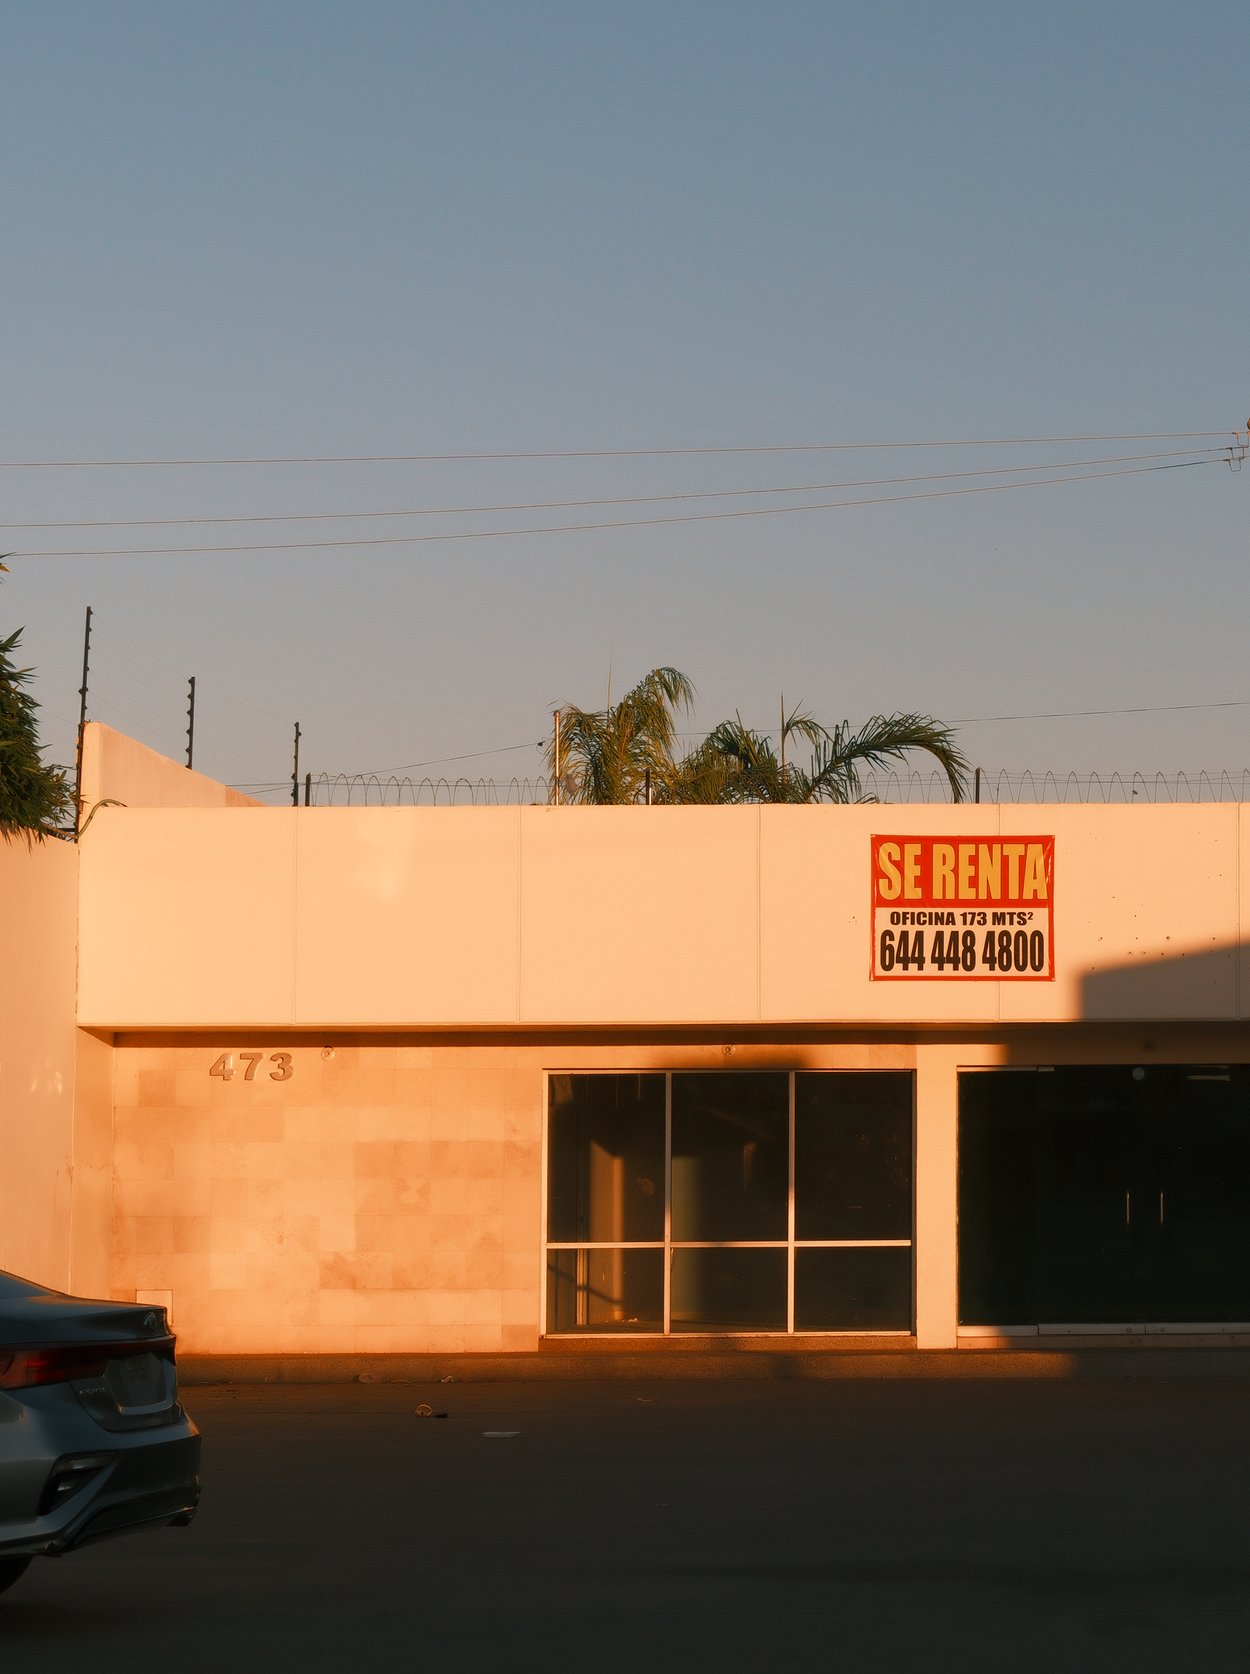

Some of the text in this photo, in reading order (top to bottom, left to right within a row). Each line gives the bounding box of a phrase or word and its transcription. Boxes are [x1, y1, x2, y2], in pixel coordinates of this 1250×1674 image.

[878, 842, 1048, 900] SE RENTA
[890, 911, 956, 926] OFICINA
[960, 911, 987, 926] 173
[880, 929, 1045, 972] 644 448 4800
[209, 1052, 294, 1081] 473
